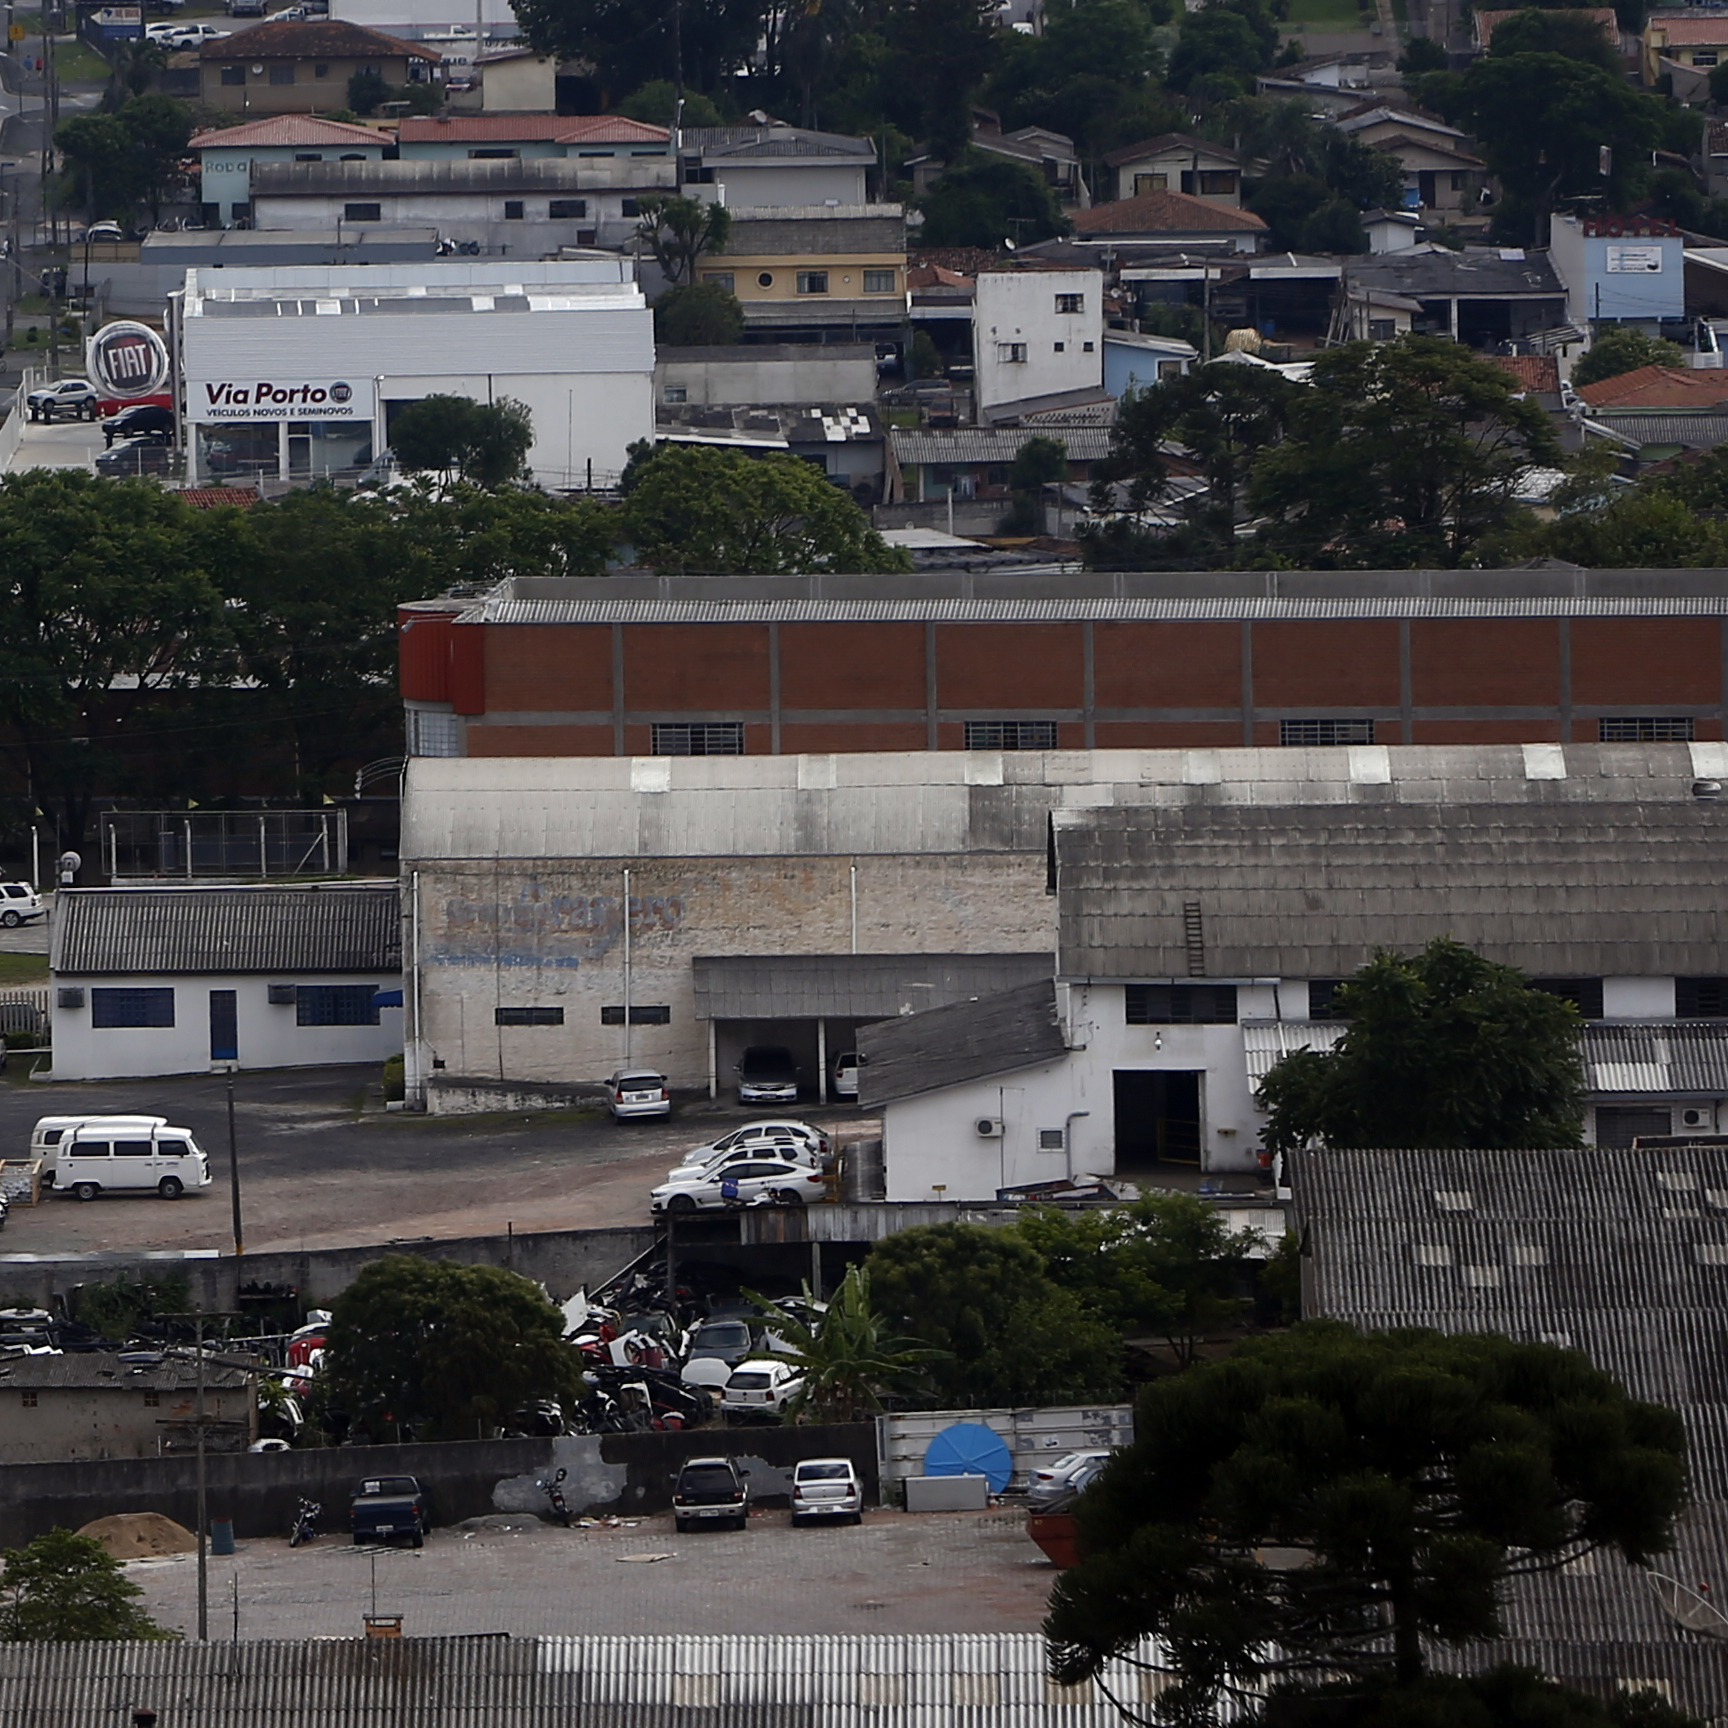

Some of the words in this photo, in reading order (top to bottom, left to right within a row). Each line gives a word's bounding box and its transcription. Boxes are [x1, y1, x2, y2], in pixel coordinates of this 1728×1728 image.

[1583, 218, 1683, 238] HOTEL
[108, 343, 146, 380] FIAT
[205, 382, 249, 405] Via
[255, 382, 327, 405] Porto
[206, 407, 250, 417] VEÍCULOS
[253, 407, 287, 417] NOVOS
[289, 407, 295, 416] E
[297, 406, 353, 416] SEMINOVOS
